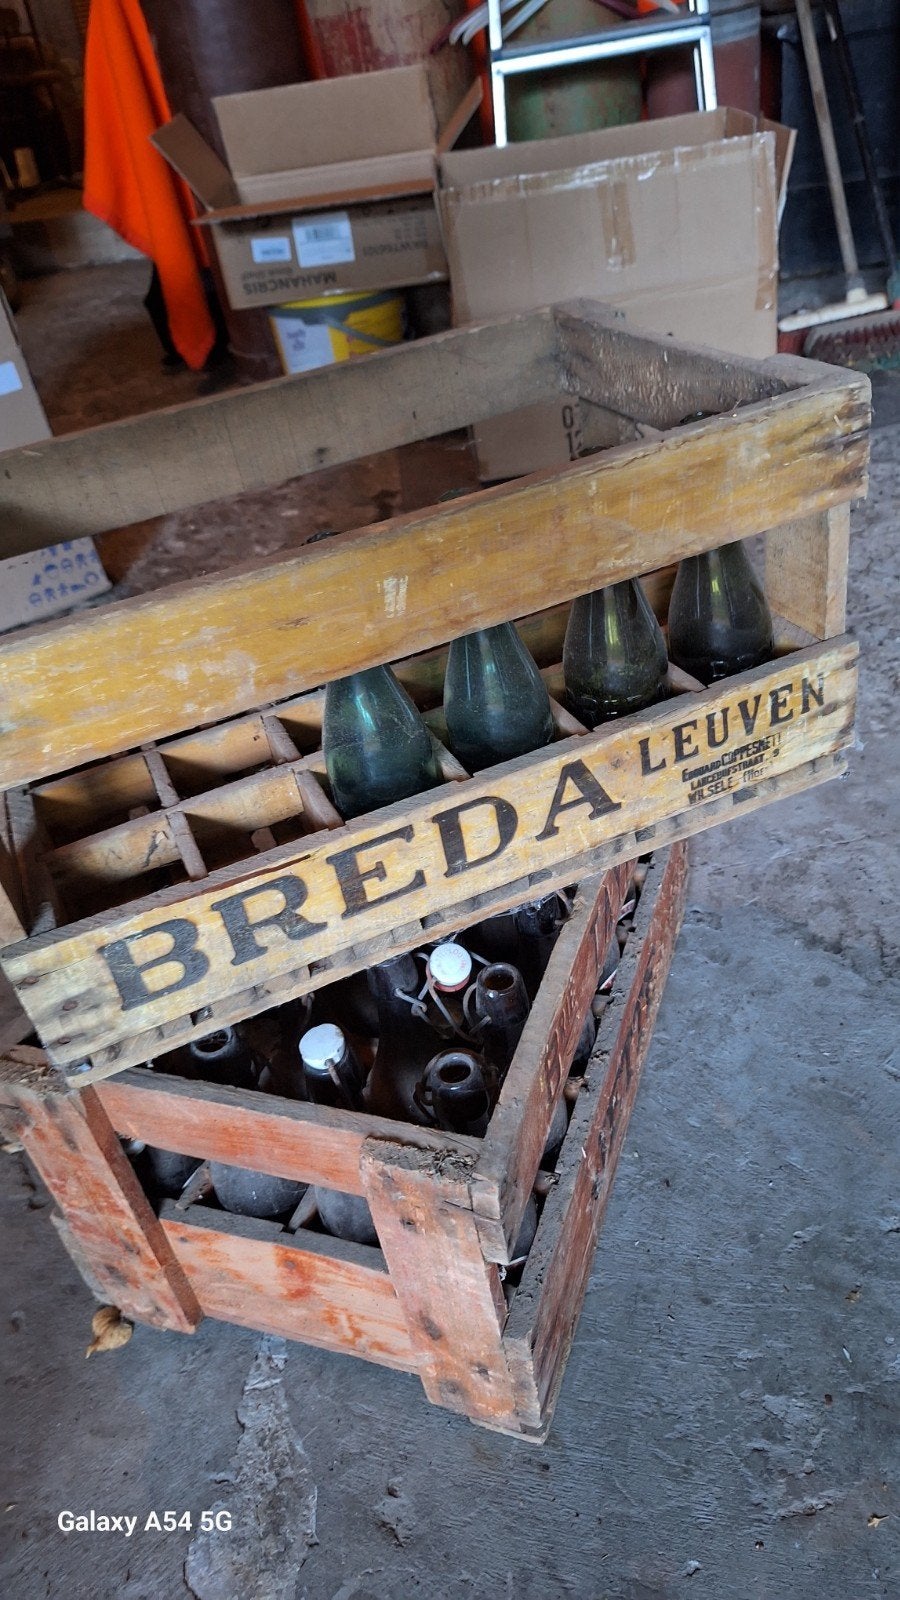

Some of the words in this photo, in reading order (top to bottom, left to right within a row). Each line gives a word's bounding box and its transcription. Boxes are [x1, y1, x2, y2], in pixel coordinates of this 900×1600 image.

[242, 271, 337, 295] MAHANCRIS
[638, 673, 825, 777] LEUVEN
[97, 758, 622, 1011] BREDA
